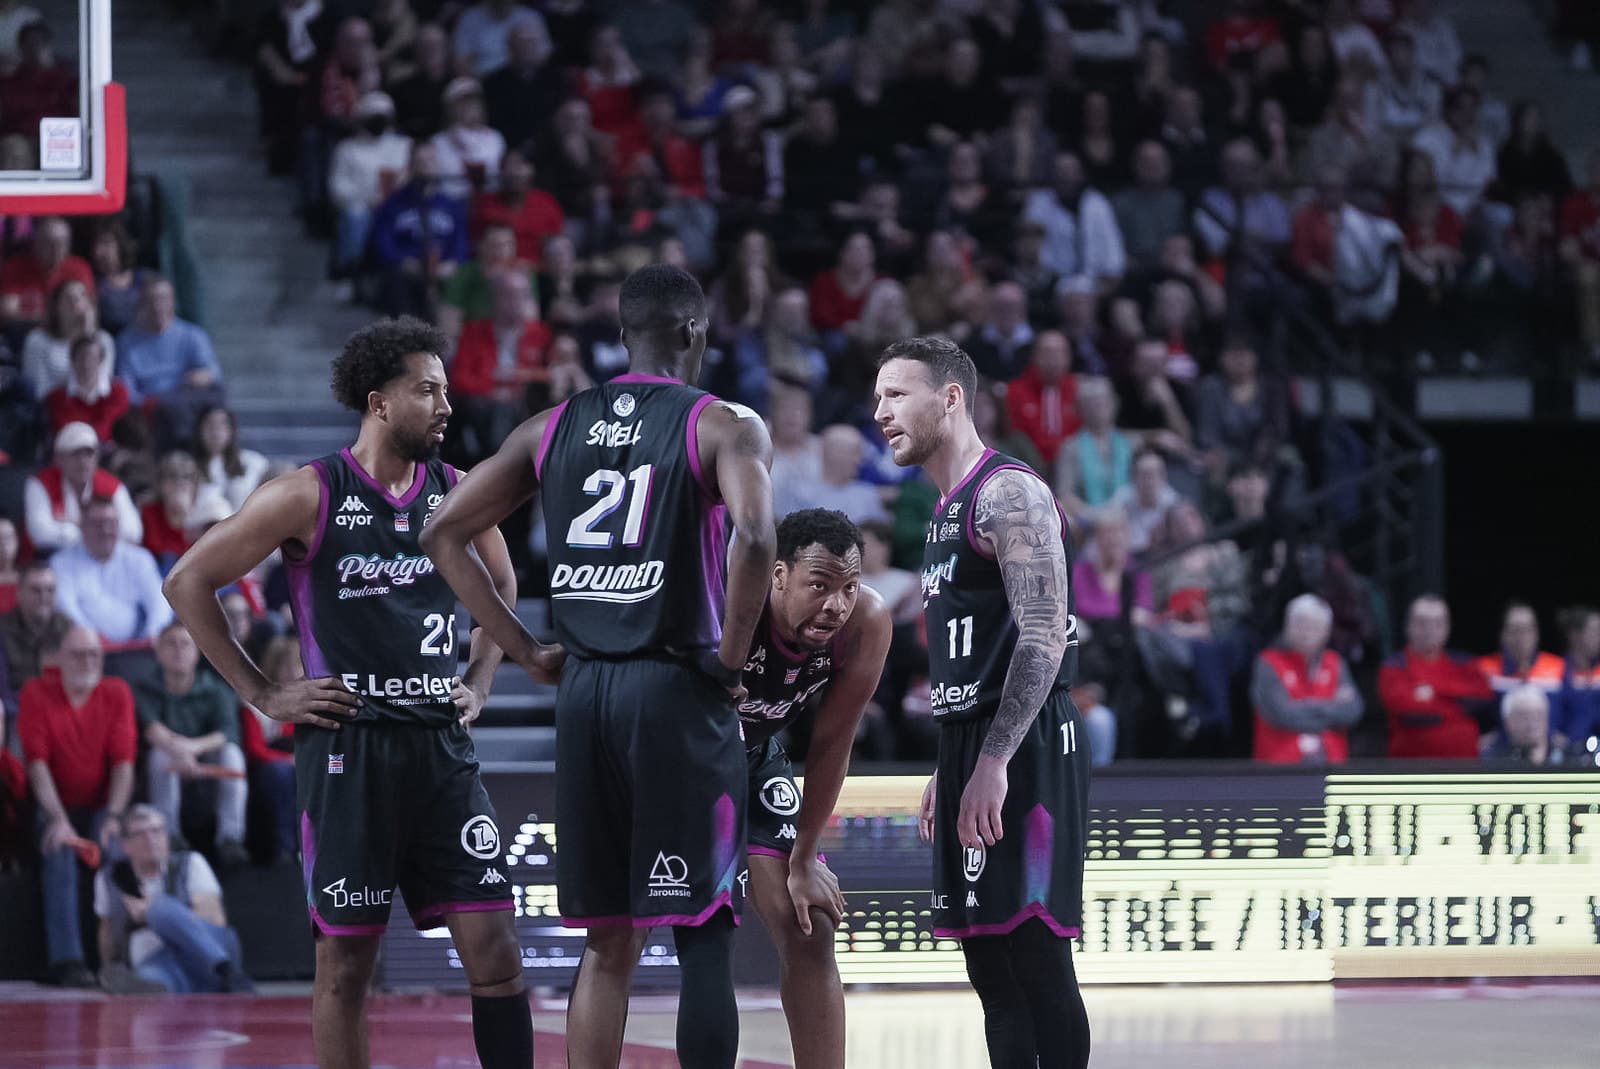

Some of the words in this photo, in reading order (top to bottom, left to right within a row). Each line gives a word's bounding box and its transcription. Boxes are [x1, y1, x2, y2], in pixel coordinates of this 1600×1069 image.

[586, 419, 643, 448] SNELL
[566, 463, 656, 549] 21
[335, 514, 373, 531] ayor
[551, 560, 665, 590] DOUMEN
[337, 586, 390, 600] Boulazac
[946, 615, 974, 660] 11
[341, 672, 459, 697] E.Lecler
[1060, 720, 1076, 755] 11
[333, 886, 392, 908] Deluc
[648, 887, 692, 898] Jaroussie
[1080, 880, 1216, 952] TRÉE
